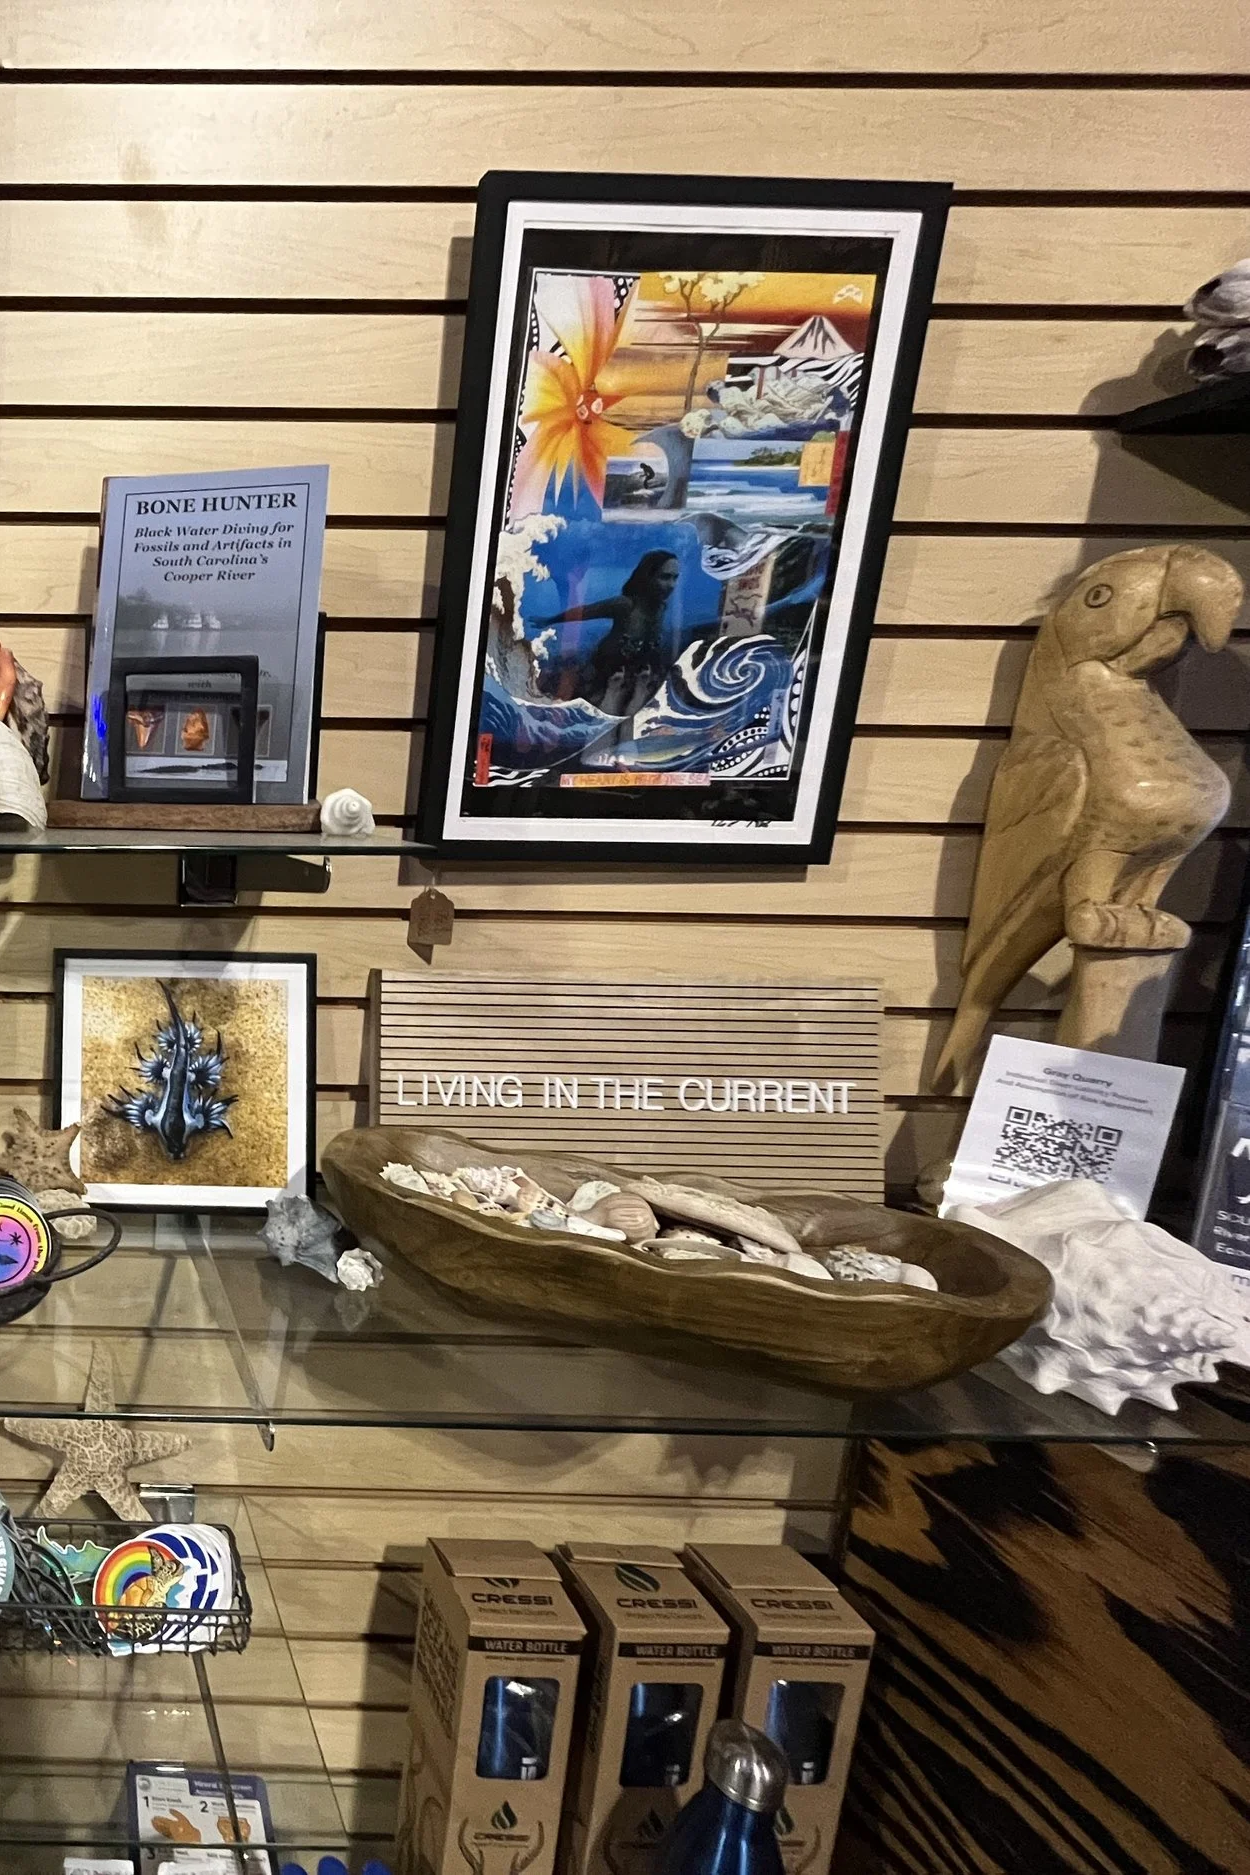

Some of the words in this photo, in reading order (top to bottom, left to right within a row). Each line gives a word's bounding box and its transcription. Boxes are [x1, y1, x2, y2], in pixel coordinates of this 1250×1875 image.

[136, 498, 196, 515] BONE
[201, 492, 297, 512] HUNTER
[134, 526, 172, 538] Black
[176, 524, 219, 537] Water
[222, 523, 269, 537] Diving
[269, 521, 294, 536] for
[134, 541, 179, 553] Fossils
[183, 540, 209, 551] and
[212, 537, 274, 552] Artifacts
[278, 537, 292, 548] in
[152, 556, 192, 567] South
[196, 553, 269, 566] Carolina's
[163, 570, 213, 584] Cooper
[217, 568, 255, 581] River
[1072, 1073, 1113, 1087] Quarry
[396, 1074, 524, 1108] LIVING
[544, 1076, 579, 1109] IN
[591, 1077, 664, 1111] THE
[678, 1078, 857, 1115] CURRENT
[472, 1593, 553, 1606] CRESSI
[616, 1598, 698, 1609] CRESSI
[751, 1599, 835, 1610] CRESSI
[485, 1640, 524, 1651] WATER
[525, 1641, 567, 1653] BOTTLE
[635, 1645, 674, 1656] WATER
[676, 1645, 718, 1657] BOTTLE
[771, 1645, 811, 1656] WATER
[812, 1646, 856, 1658] BOTTLE
[144, 1796, 149, 1808] 1
[200, 1801, 209, 1813] 2
